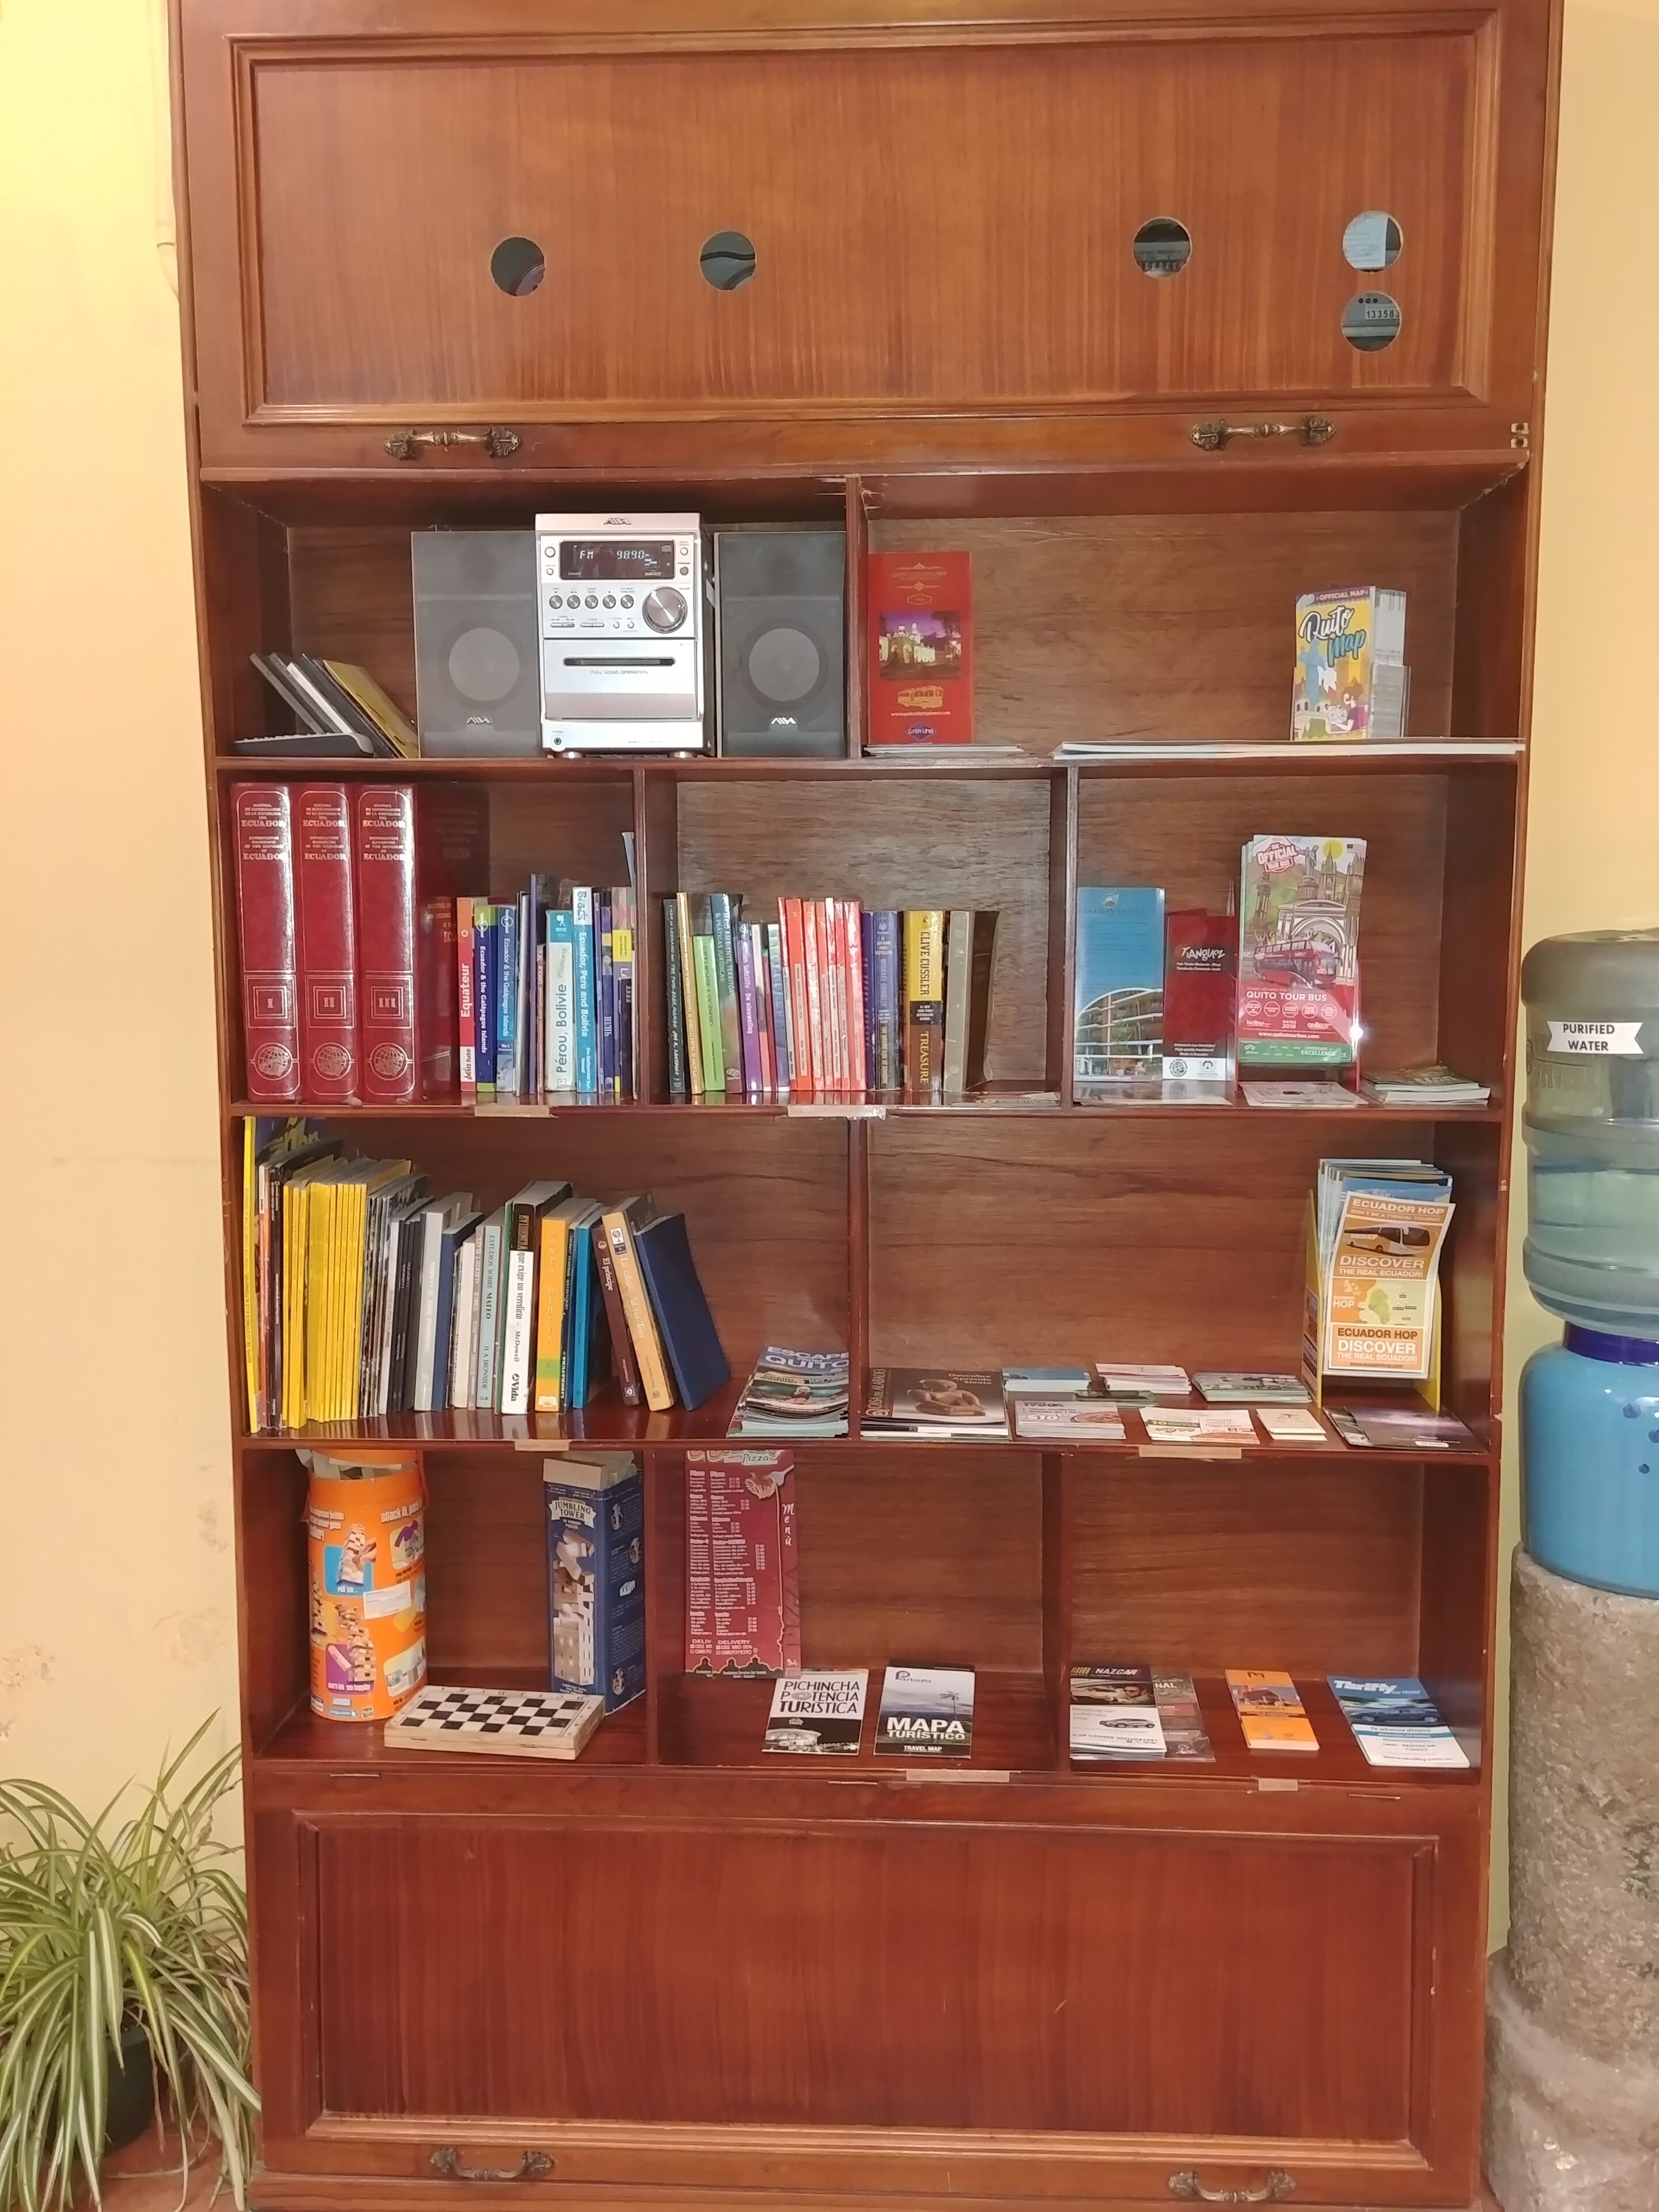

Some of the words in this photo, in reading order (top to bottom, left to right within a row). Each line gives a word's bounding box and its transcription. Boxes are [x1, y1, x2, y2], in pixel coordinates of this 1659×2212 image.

[579, 551, 594, 559] FM
[1319, 591, 1349, 600] OFFICIAL
[1299, 606, 1355, 643] Quito
[1257, 845, 1297, 864] OFFICIAL
[716, 919, 724, 948] PRÁTICAS
[579, 932, 588, 968] Ecuador,
[920, 931, 930, 956] CLIVE
[558, 949, 567, 978] routard
[718, 949, 726, 981] JURÍDICAS
[727, 964, 736, 1001] TERRITÓRIO
[920, 958, 930, 995] CUSSLER
[461, 963, 470, 1018] Equateur
[1247, 991, 1277, 999] QUITO
[1279, 993, 1305, 1001] TOUR
[378, 998, 396, 1008] III
[555, 984, 567, 1027] Bolivie
[581, 1009, 589, 1037] Bolivia
[1563, 1024, 1615, 1035] PURIFIED
[556, 1031, 567, 1073] Pérou,
[1567, 1040, 1609, 1051] WATER
[920, 1031, 929, 1084] TREASURE
[1353, 1199, 1416, 1213] ECUADOR
[1418, 1207, 1444, 1215] HOP
[517, 1252, 527, 1264] que
[1340, 1256, 1425, 1268] DISCOVER
[516, 1265, 526, 1281] exige
[603, 1266, 614, 1291] príncipe
[517, 1283, 524, 1291] un
[515, 1292, 525, 1319] veredicto
[620, 1257, 629, 1268] La
[635, 1321, 645, 1339] Tom
[1333, 1300, 1354, 1308] HOP
[1338, 1328, 1391, 1338] ECUADOR
[1395, 1331, 1418, 1339] HOP
[1338, 1339, 1416, 1354] DISCOVER
[765, 1355, 849, 1369] QUITO
[482, 1360, 490, 1390] IRONSIDE
[510, 1382, 520, 1402] Vida
[868, 1397, 882, 1408] CASA
[743, 1454, 769, 1462] Pizza
[555, 1502, 591, 1514] JUMBLING
[560, 1509, 584, 1520] TOWER
[783, 1681, 859, 1691] PICHINCHA
[1333, 1680, 1397, 1694] Thrifty
[779, 1700, 858, 1714] TURÍSTICA
[887, 1717, 965, 1733] MAPA
[887, 1729, 965, 1740] TURÍSTICO
